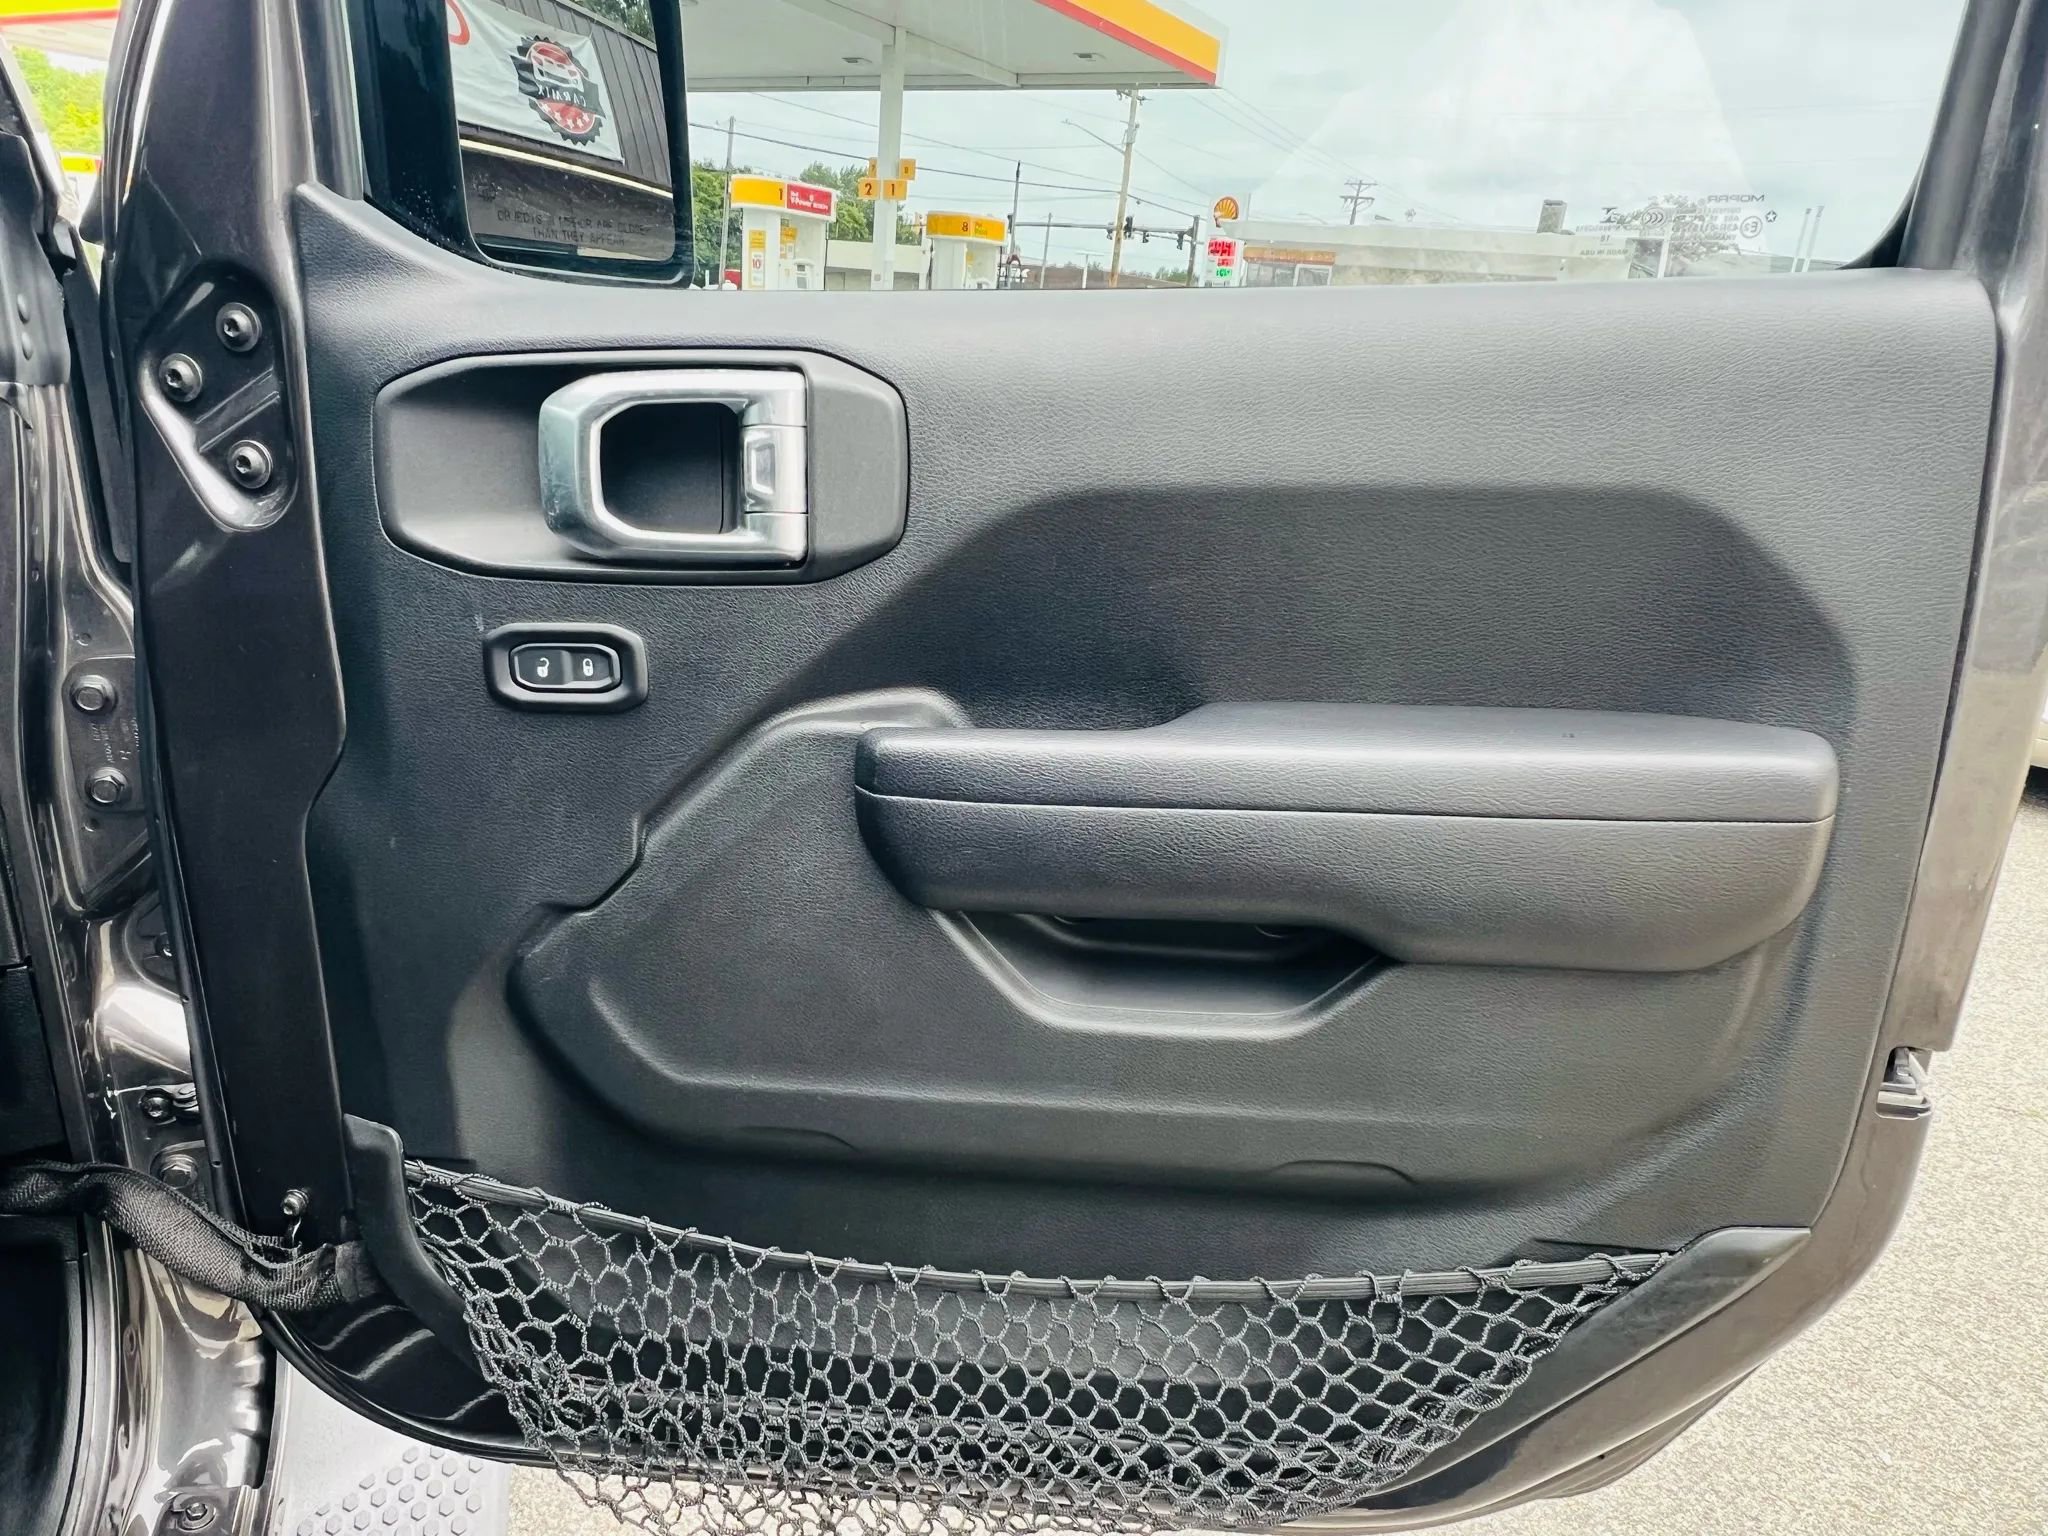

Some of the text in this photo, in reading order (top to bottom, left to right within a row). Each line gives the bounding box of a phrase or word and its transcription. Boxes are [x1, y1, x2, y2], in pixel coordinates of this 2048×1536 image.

[778, 188, 783, 200] 1
[864, 182, 872, 195] 2
[891, 183, 895, 196] 1
[962, 222, 969, 232] 8
[561, 229, 585, 242] THEY
